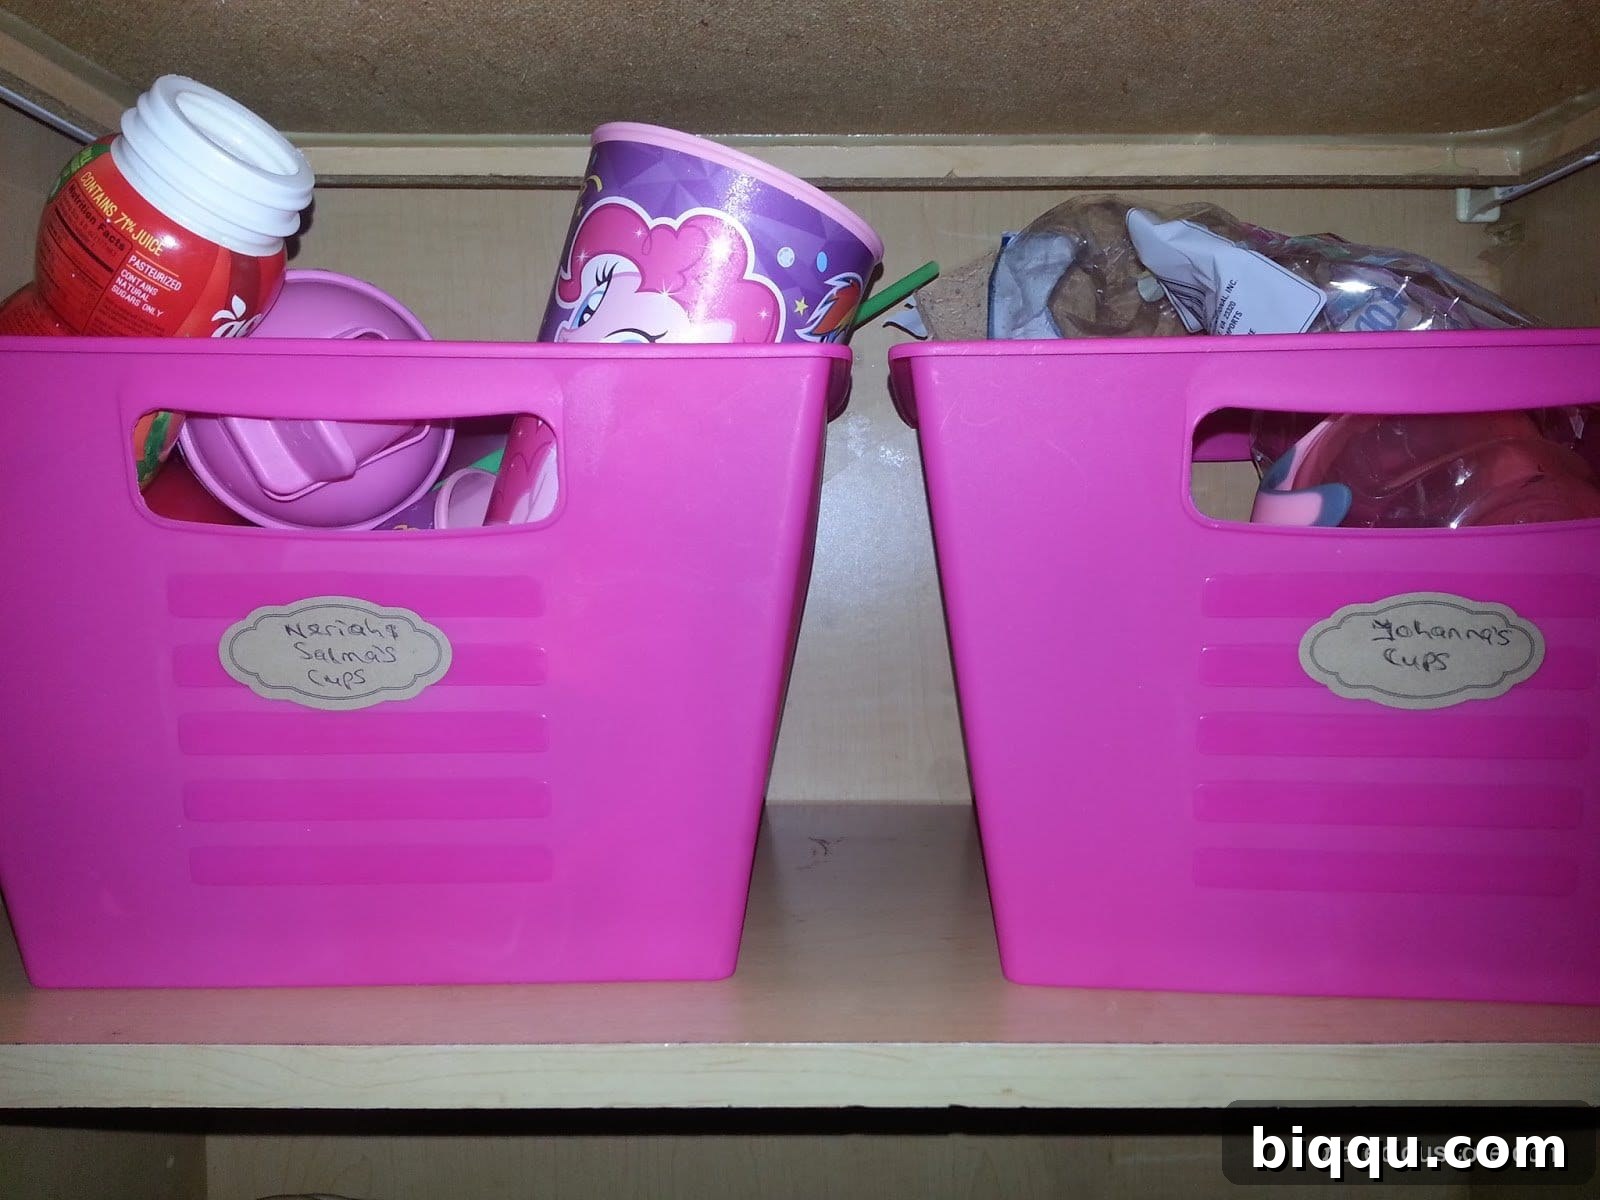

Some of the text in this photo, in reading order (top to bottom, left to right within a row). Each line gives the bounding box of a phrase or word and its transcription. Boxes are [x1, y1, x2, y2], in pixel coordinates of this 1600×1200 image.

[81, 171, 164, 256] CONTAINS 71% JUICE
[98, 223, 126, 251] Facts
[120, 269, 159, 296] CONTAINS
[128, 255, 182, 291] PASTEURIZED
[111, 284, 164, 317] SUGARS ONLY
[115, 277, 149, 302] NATURAL
